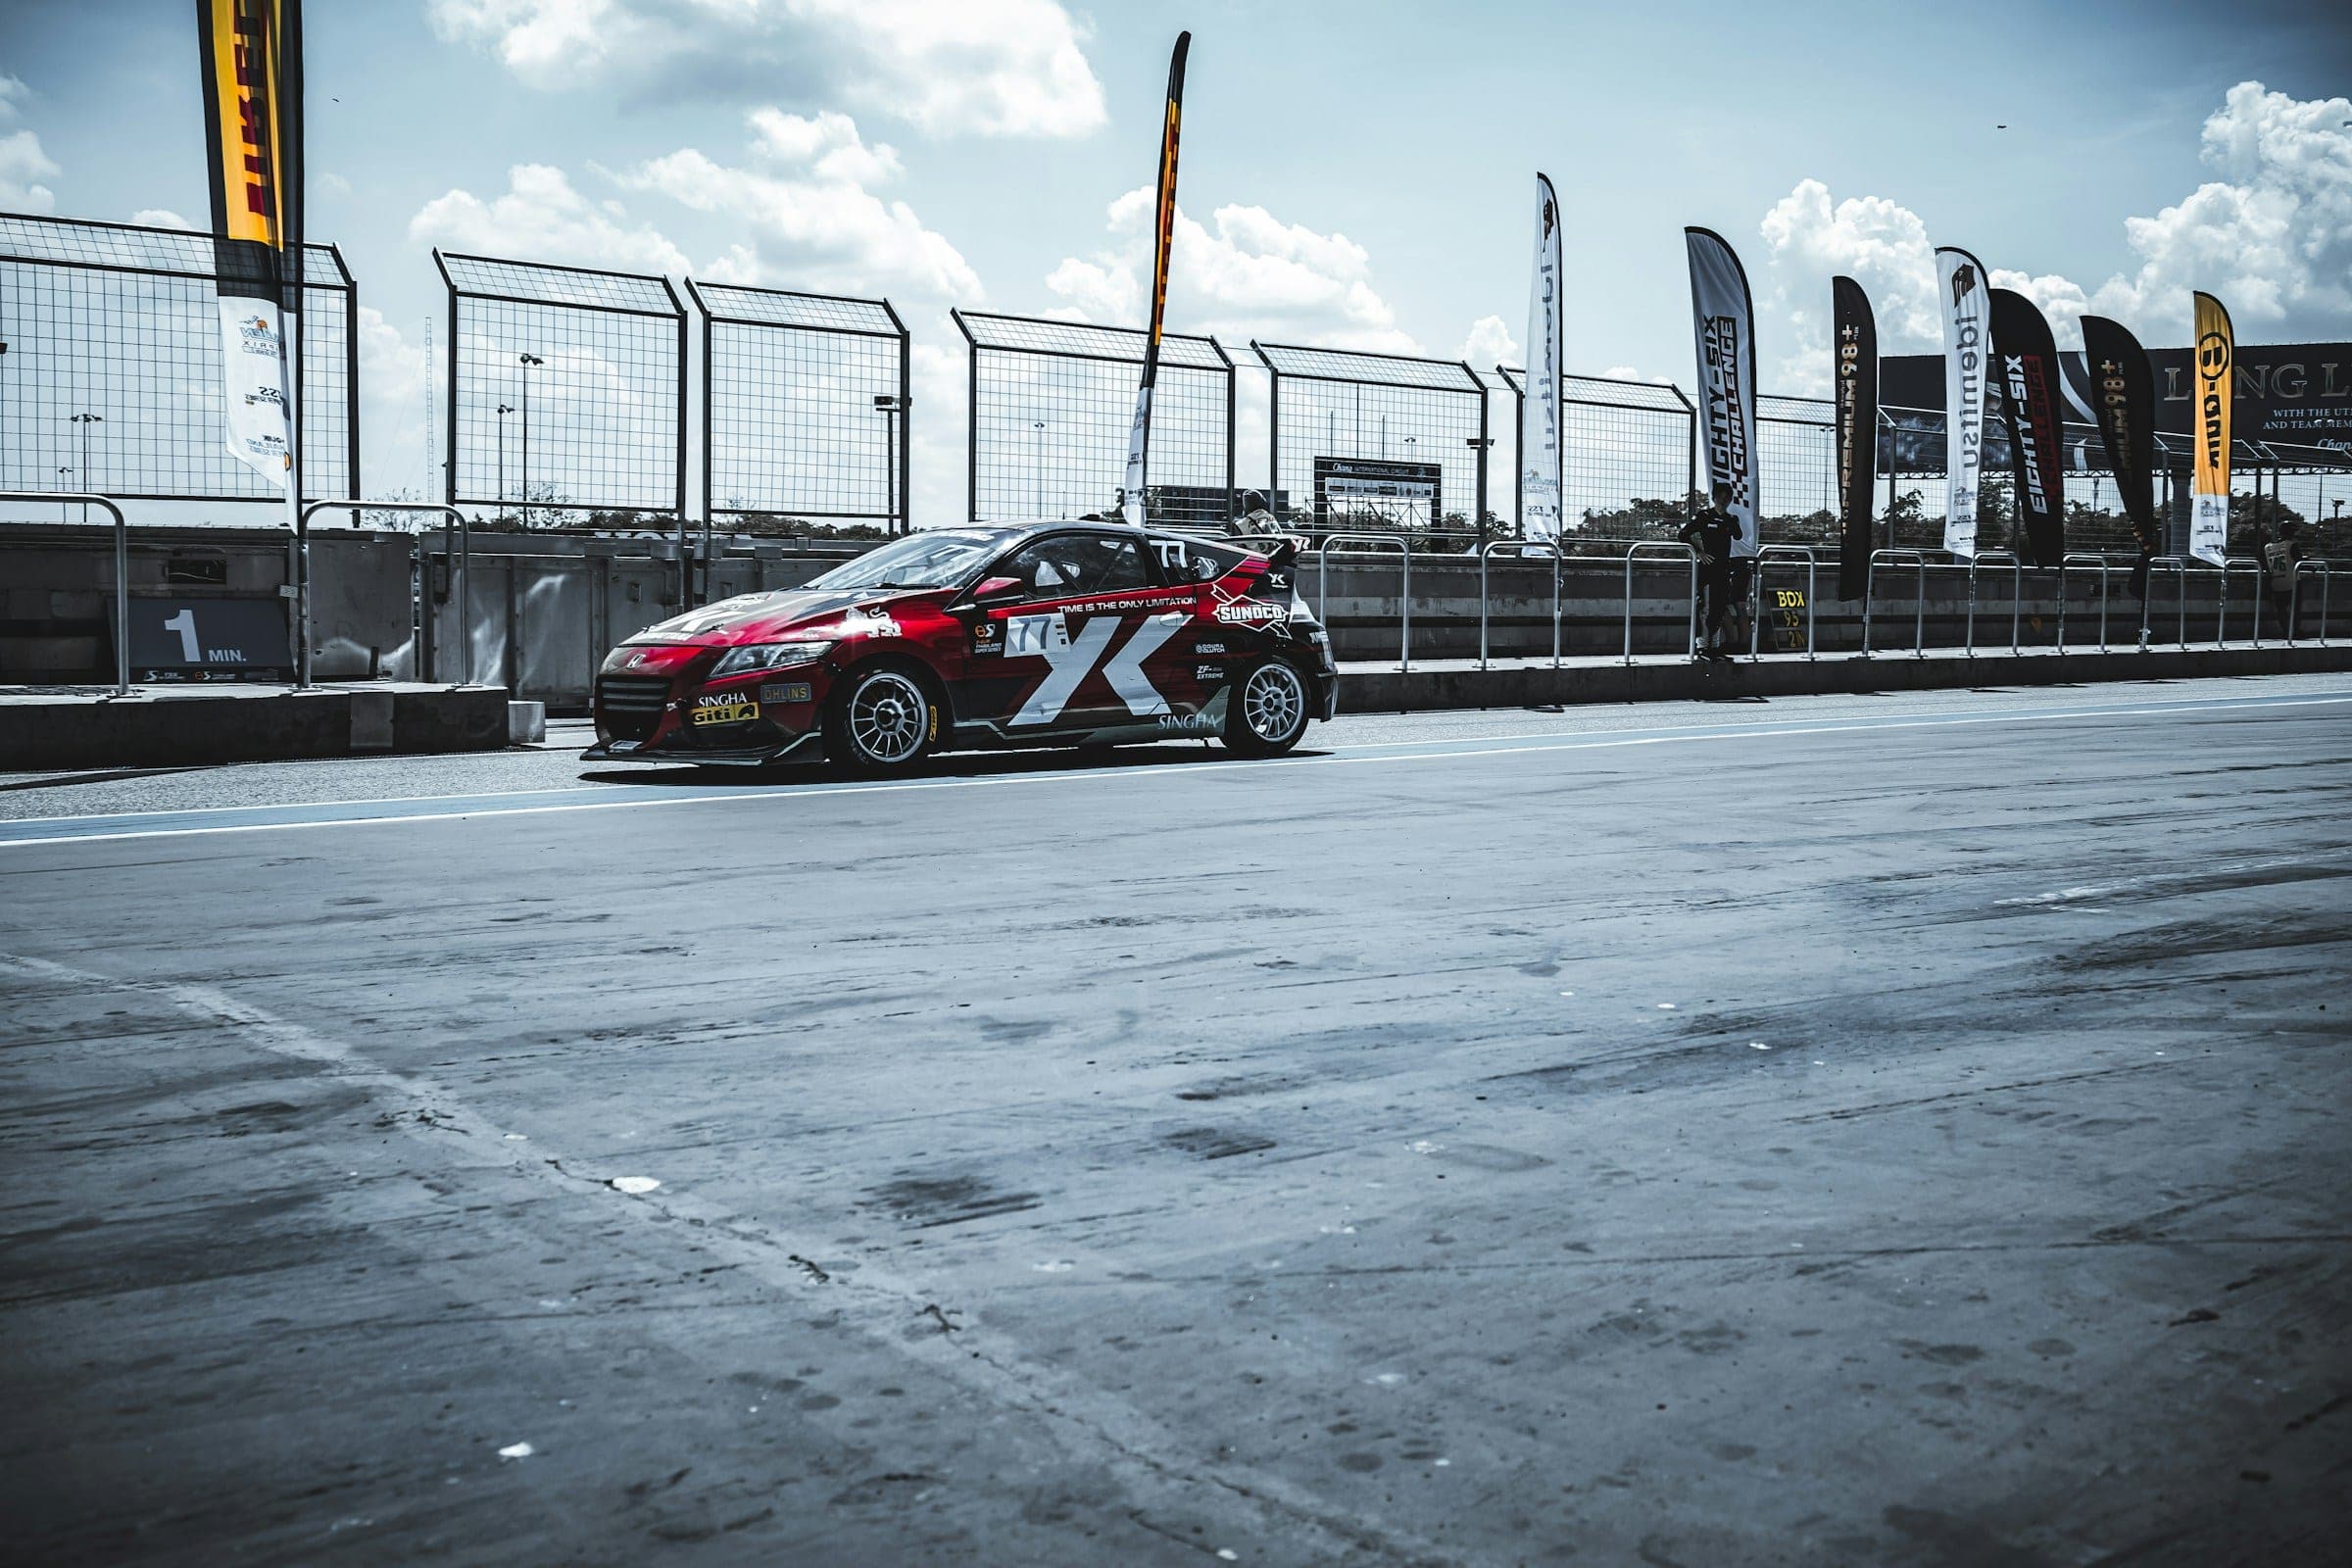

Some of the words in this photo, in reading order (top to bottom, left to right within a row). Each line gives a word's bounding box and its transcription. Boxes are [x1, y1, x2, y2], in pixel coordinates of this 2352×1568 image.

[2164, 364, 2308, 400] LNG
[1703, 314, 1731, 485] IGHTY-SIX
[1719, 319, 1745, 471] CHALLENGE
[2274, 409, 2304, 417] WITH
[2263, 421, 2288, 430] AND
[2005, 355, 2048, 514] EIGHTY-SIX
[1149, 540, 1188, 568] 77
[1057, 605, 1083, 614] TIME
[1085, 603, 1095, 612] IS
[1097, 601, 1117, 611] THE
[1118, 599, 1145, 610] ONLY
[1146, 597, 1198, 609] LIMITATION
[1777, 591, 1805, 608] BOX
[1220, 605, 1283, 621] SUNOCO
[164, 609, 201, 662] 1
[208, 649, 247, 662] MIN.
[1016, 615, 1052, 652] 77
[699, 692, 748, 709] SINGHA
[694, 709, 731, 723] Giti
[1158, 713, 1217, 729] SINGHA
